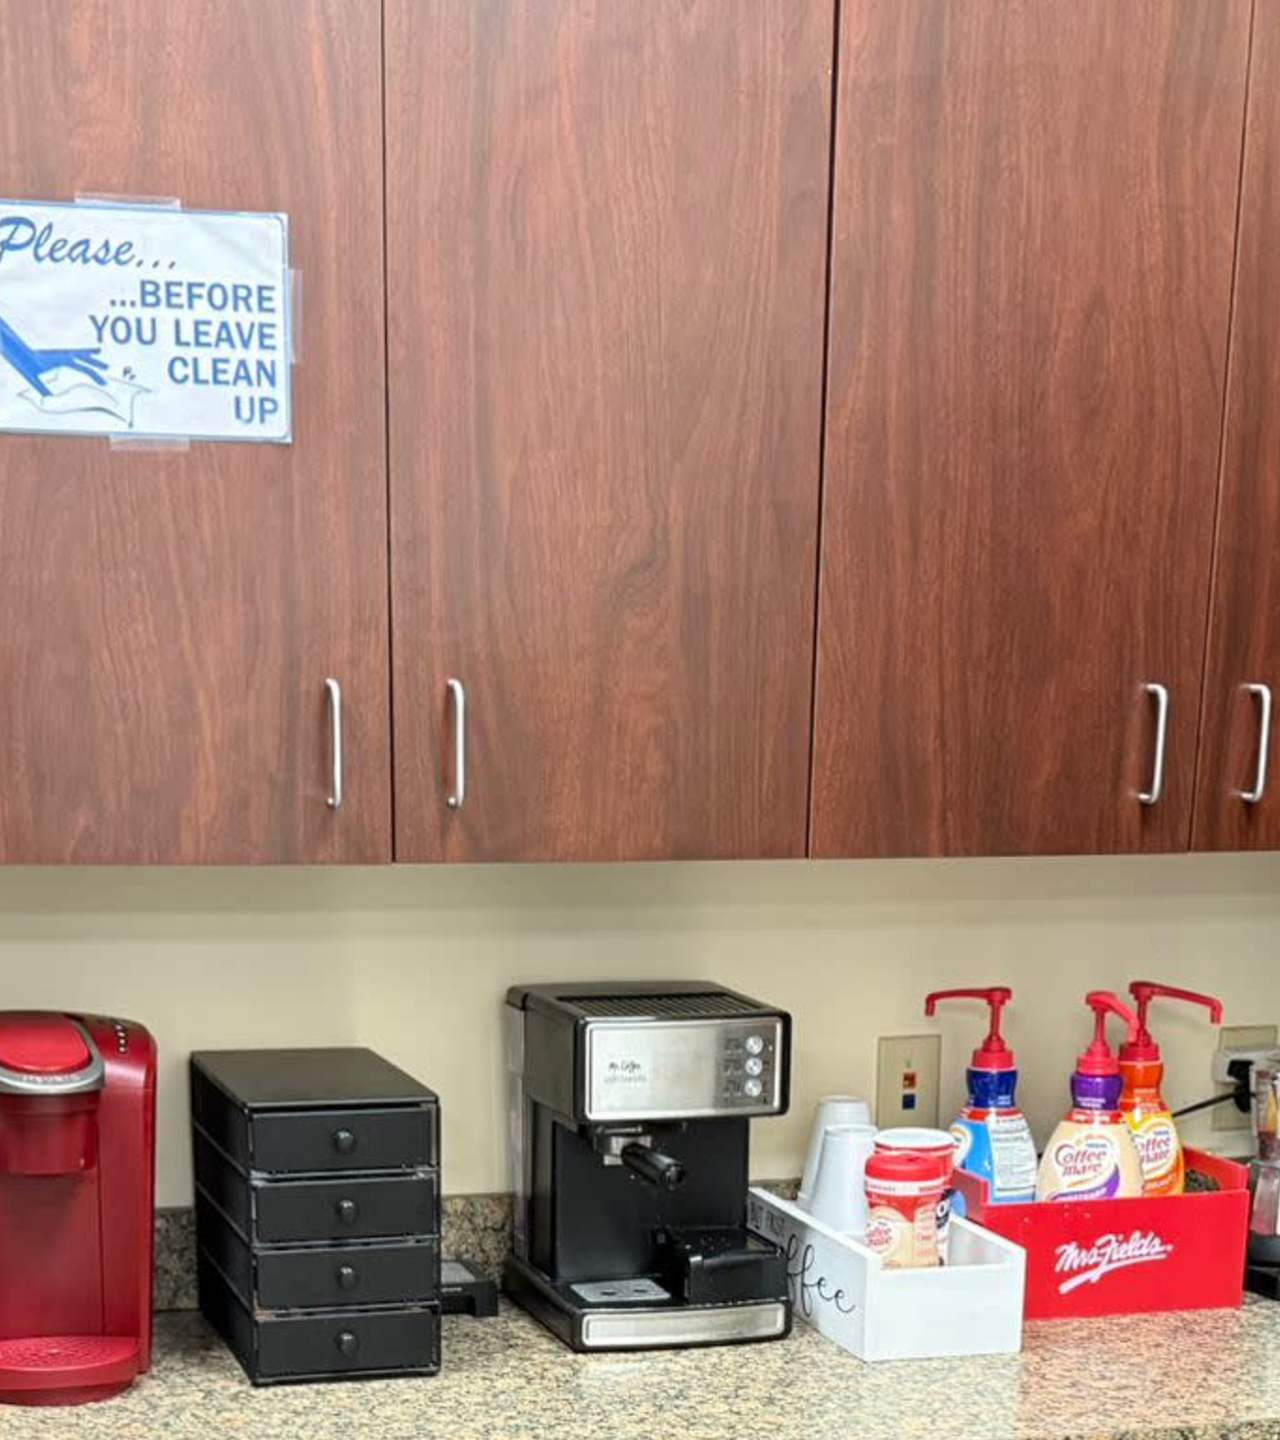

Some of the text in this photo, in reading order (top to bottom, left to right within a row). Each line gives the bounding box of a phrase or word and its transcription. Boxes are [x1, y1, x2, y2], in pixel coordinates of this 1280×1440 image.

[110, 280, 276, 313] ...BEFORE
[89, 315, 277, 350] YOU LEAVE
[168, 356, 277, 388] CLEAN
[235, 396, 278, 424] UP
[1054, 1144, 1107, 1167] Coffee
[786, 1233, 856, 1317] ffee
